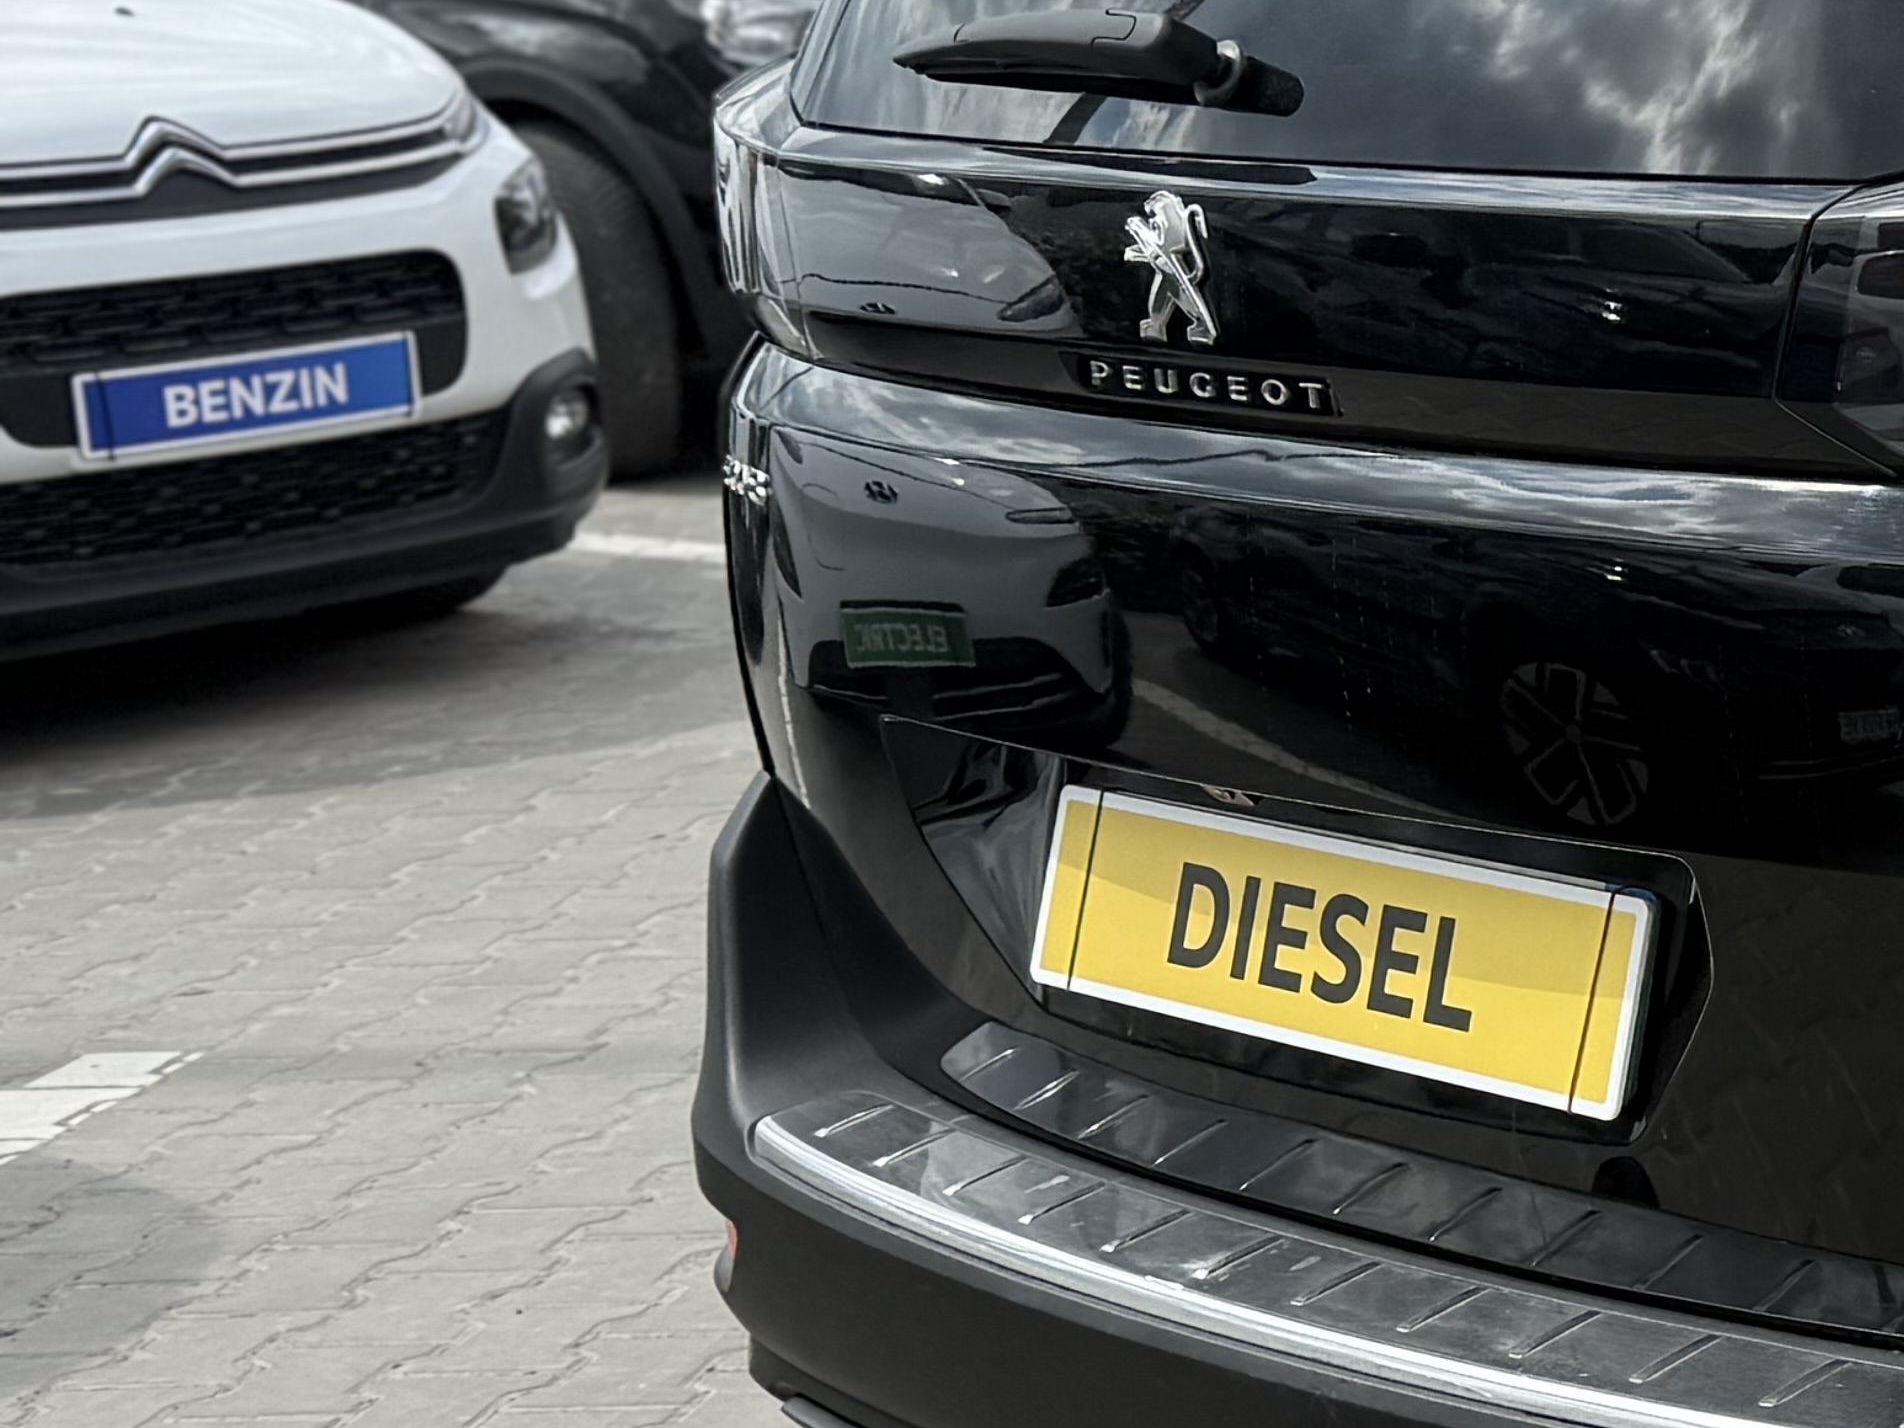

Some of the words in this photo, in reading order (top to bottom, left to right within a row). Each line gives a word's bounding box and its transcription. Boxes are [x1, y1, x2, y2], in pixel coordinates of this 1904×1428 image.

[162, 361, 349, 430] BENZIN
[1088, 358, 1327, 411] PEUGEOT
[1166, 861, 1473, 1033] DIESEL
